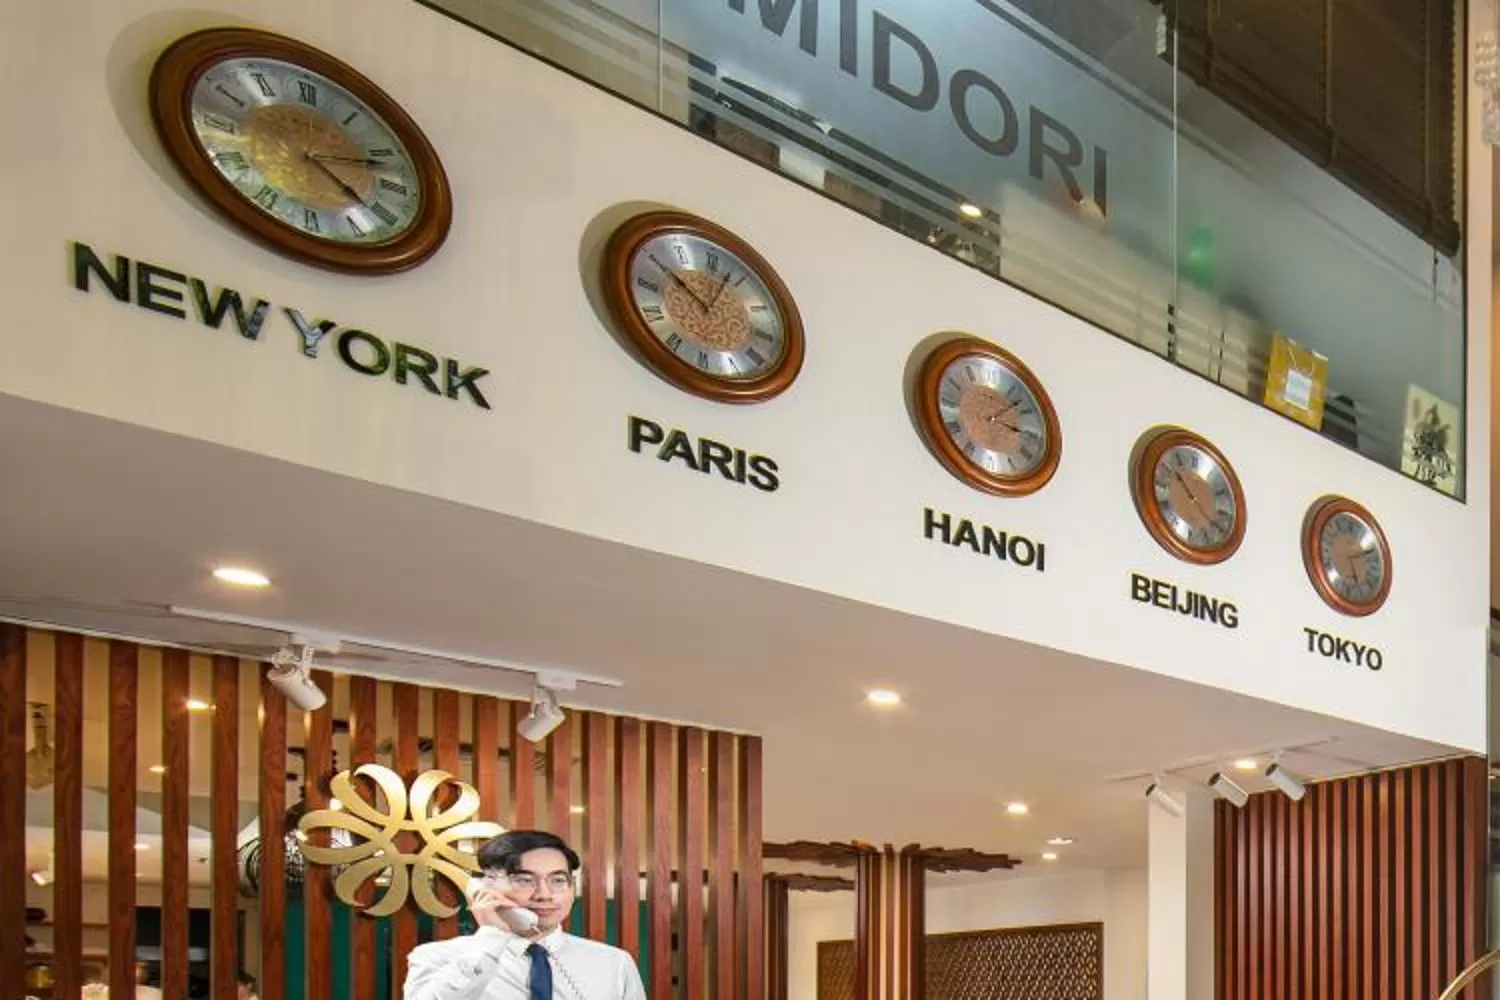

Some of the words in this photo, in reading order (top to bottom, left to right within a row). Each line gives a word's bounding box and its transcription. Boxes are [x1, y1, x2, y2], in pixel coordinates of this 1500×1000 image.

[72, 240, 270, 341] NEW
[280, 306, 492, 411] YORK
[628, 414, 781, 493] PARIS
[923, 507, 1046, 572] HANOI
[1130, 573, 1239, 629] BEIJING
[1303, 627, 1384, 671] TOKYO
